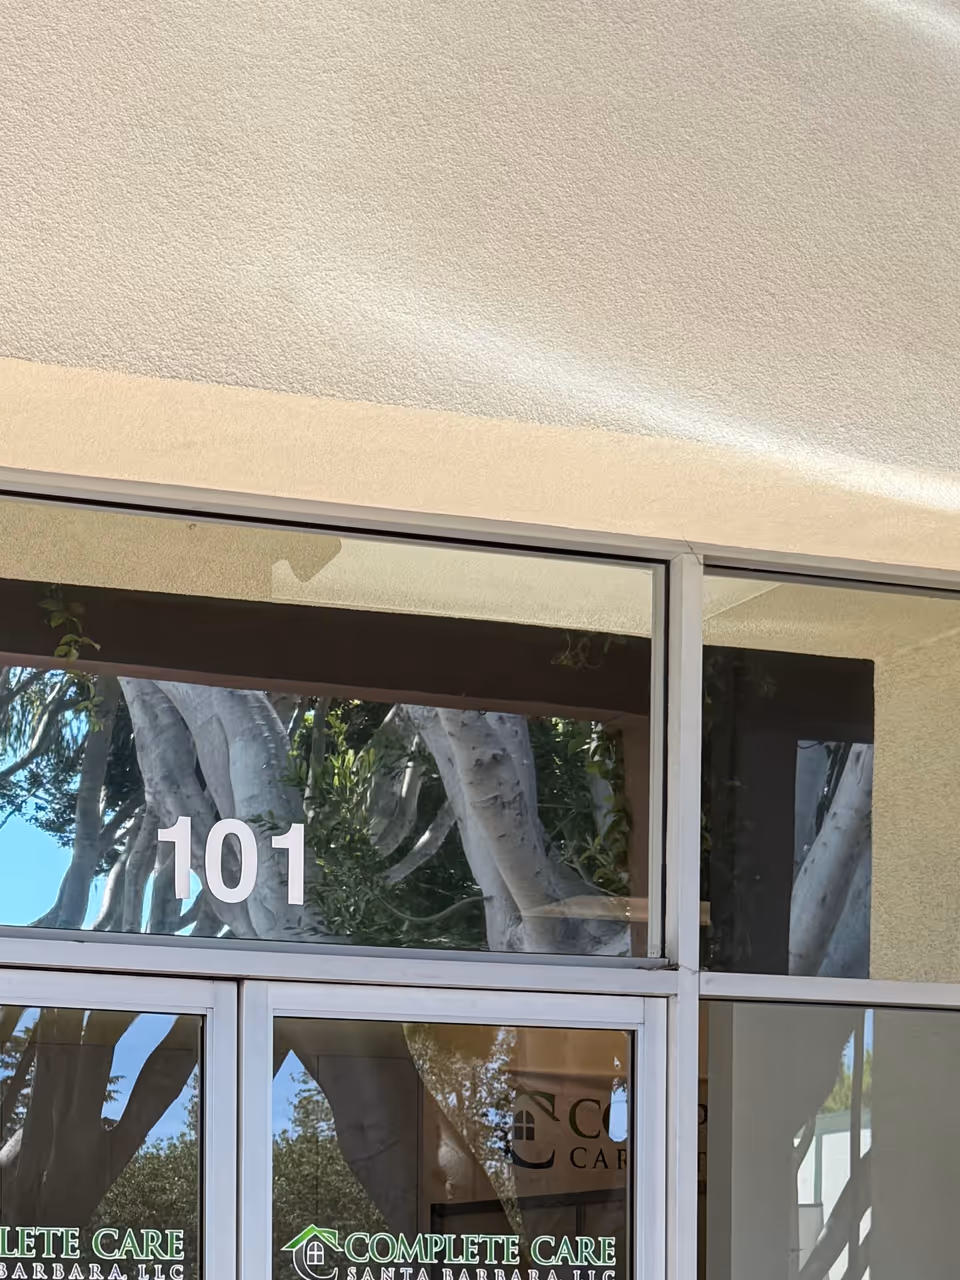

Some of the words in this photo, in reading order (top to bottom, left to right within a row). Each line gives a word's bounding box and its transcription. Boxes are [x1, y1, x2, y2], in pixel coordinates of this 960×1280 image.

[157, 816, 305, 906] 101
[92, 1228, 184, 1261] CARE
[343, 1232, 520, 1265] COMPLETE
[530, 1235, 617, 1267] CARE
[138, 1264, 184, 1280] LLC
